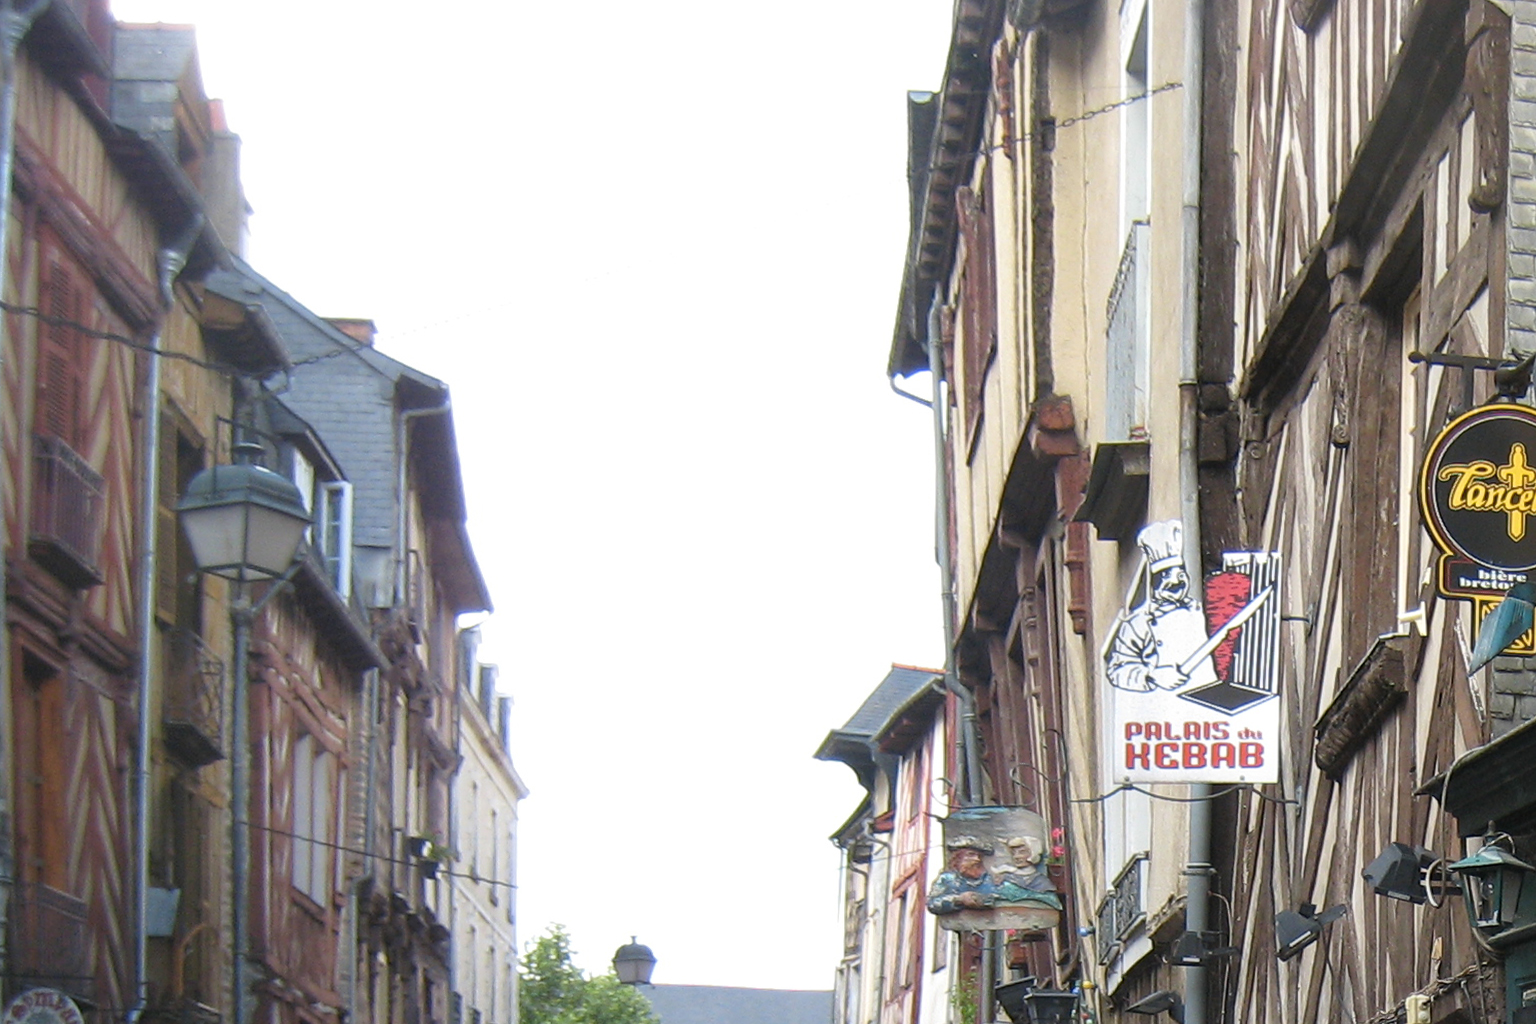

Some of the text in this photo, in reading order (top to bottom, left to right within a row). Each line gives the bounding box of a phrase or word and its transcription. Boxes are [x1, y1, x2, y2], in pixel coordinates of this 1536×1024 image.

[1478, 568, 1527, 583] bière
[1124, 721, 1263, 740] PALAIS du
[1125, 741, 1264, 770] KEBAB
